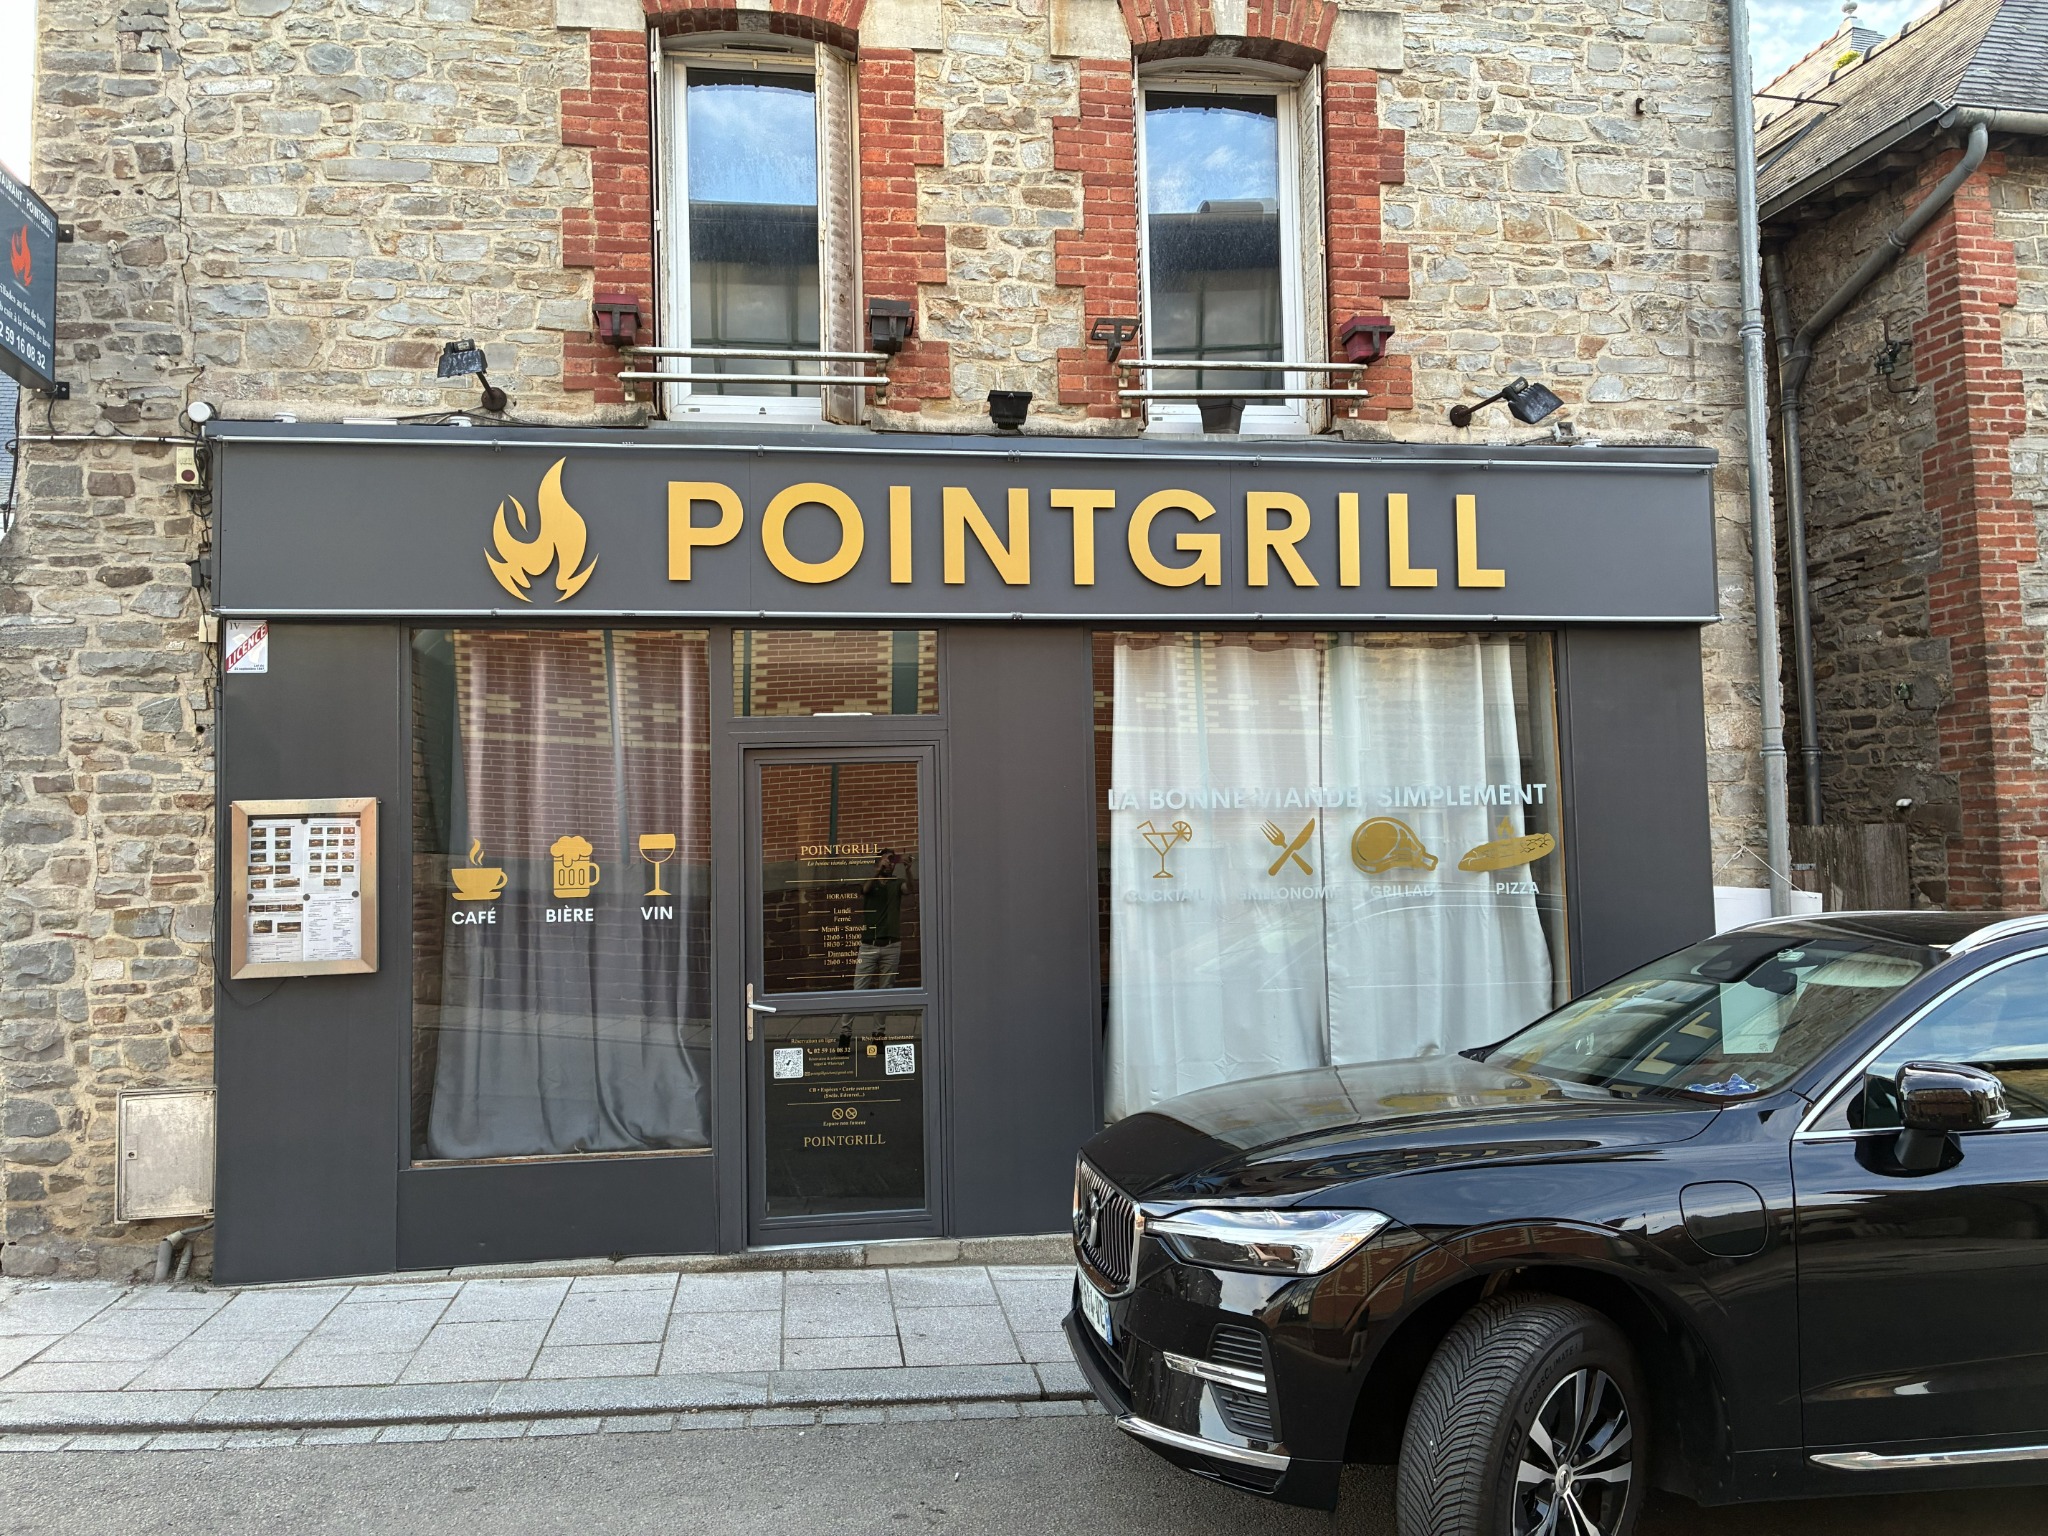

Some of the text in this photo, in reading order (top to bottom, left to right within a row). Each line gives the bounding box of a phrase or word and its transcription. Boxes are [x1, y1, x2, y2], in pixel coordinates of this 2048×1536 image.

[26, 197, 53, 234] POINTGRILL
[5, 325, 15, 346] 59
[16, 335, 26, 354] 16
[26, 343, 36, 362] 08
[36, 350, 46, 370] 32
[667, 480, 1507, 589] POINTGRILL
[229, 622, 241, 630] IV
[228, 624, 266, 669] LICENCE
[1108, 788, 1140, 810] LA
[1149, 787, 1246, 810] BONNE
[1377, 783, 1547, 808] SIMPLEMENT
[800, 843, 882, 856] POINTGRILL
[1495, 881, 1540, 895] PIZZA
[451, 907, 497, 925] CAFÉ
[545, 904, 594, 923] BIÈRE
[640, 906, 673, 920] VIN
[844, 924, 867, 932] Samedi
[803, 1133, 886, 1148] POINTGRILL
